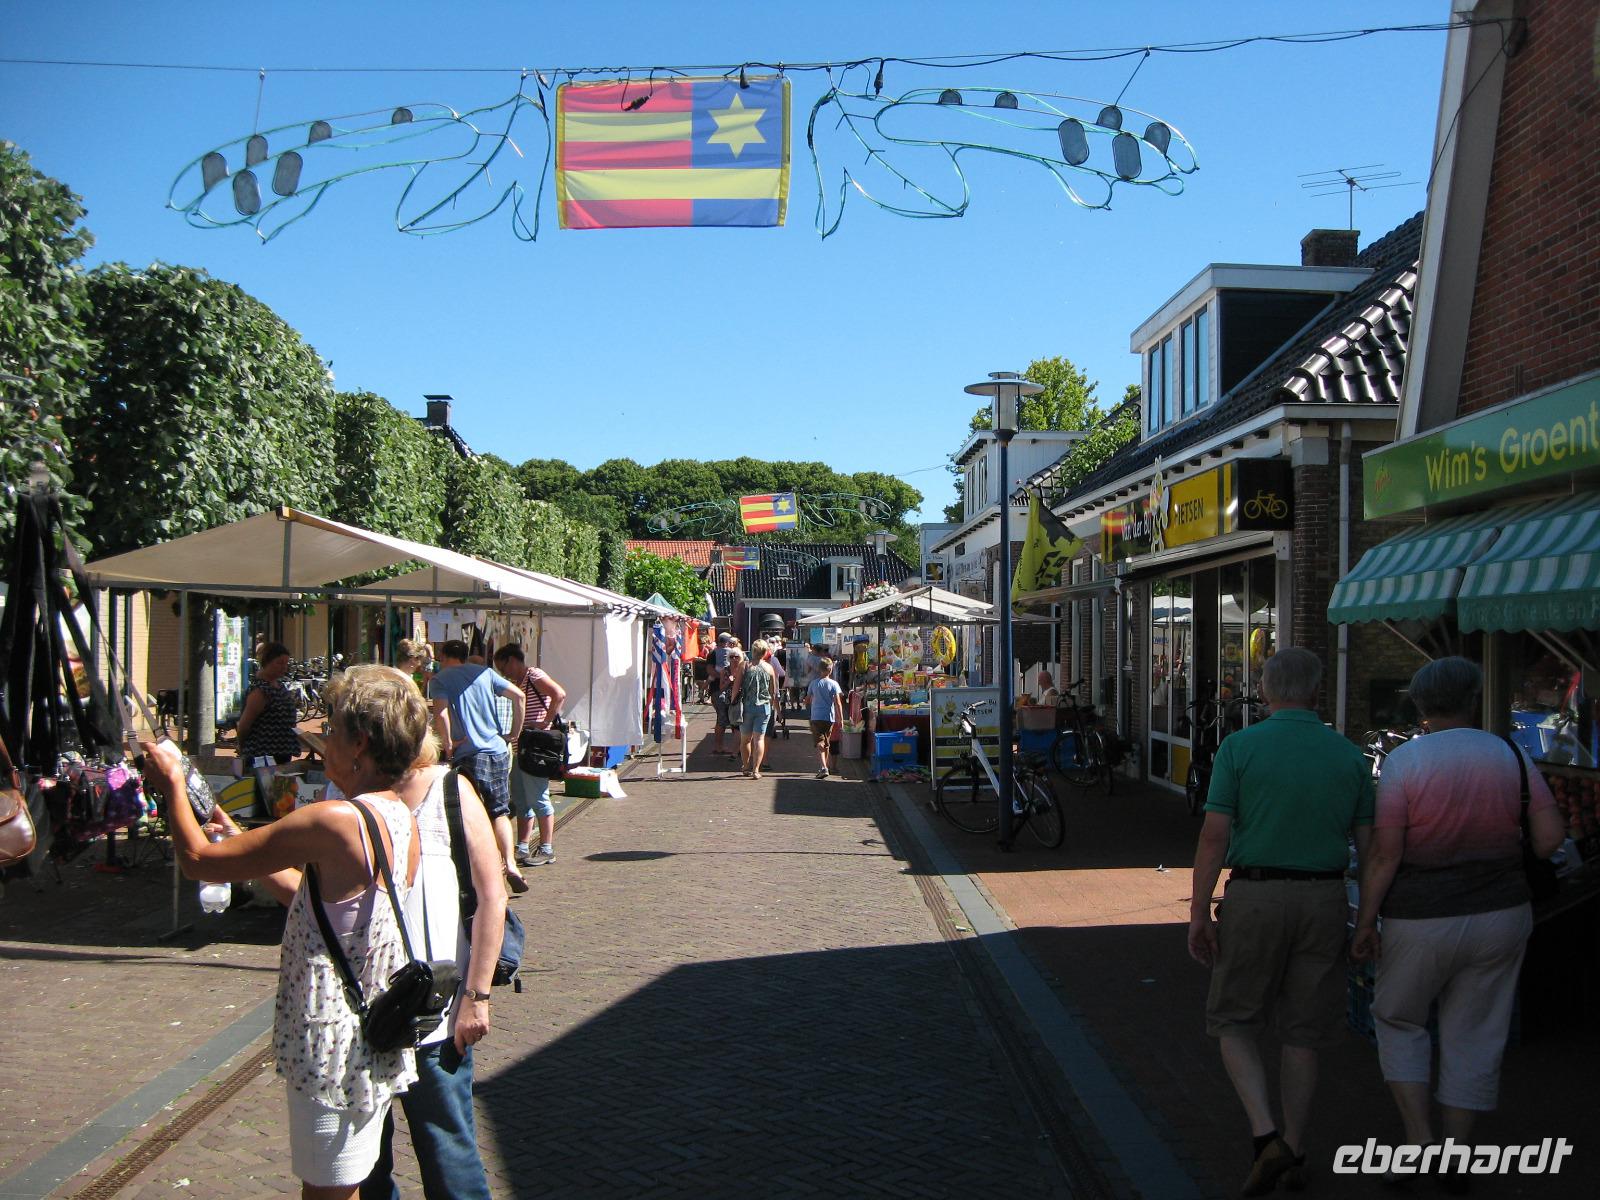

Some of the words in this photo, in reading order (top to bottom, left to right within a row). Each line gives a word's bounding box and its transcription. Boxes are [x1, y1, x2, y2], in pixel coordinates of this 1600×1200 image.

[1425, 440, 1487, 493] Wim's
[1499, 400, 1600, 474] Groent
[1132, 513, 1143, 538] der
